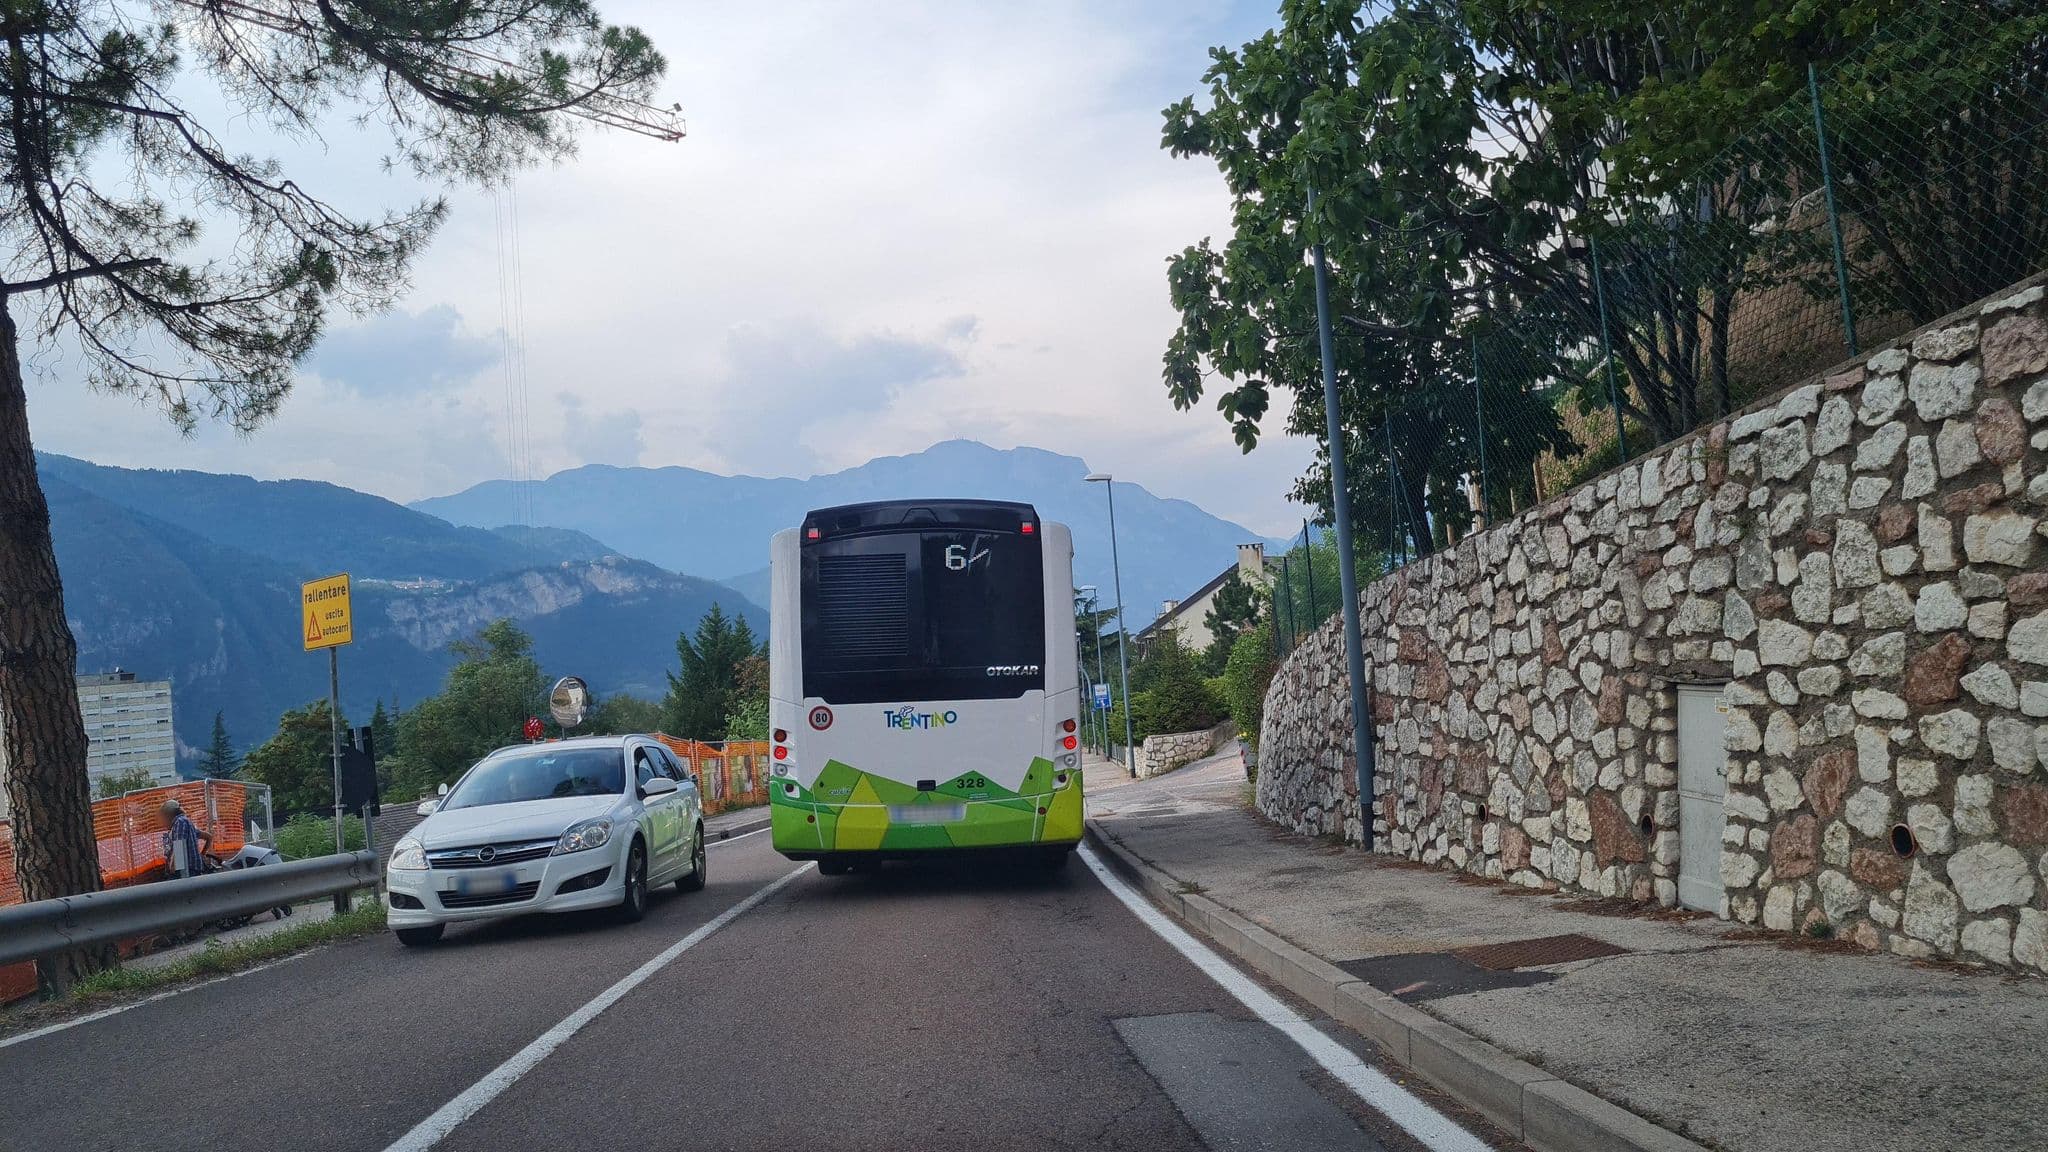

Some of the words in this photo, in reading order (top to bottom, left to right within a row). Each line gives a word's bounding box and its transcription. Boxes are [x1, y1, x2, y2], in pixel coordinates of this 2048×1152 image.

[304, 585, 347, 604] rallentare
[325, 607, 344, 620] uscita
[322, 622, 349, 636] autocarri
[986, 665, 1039, 676] OTOKAR
[815, 712, 828, 723] 80
[883, 709, 957, 730] TRENTINO
[956, 777, 985, 789] 328
